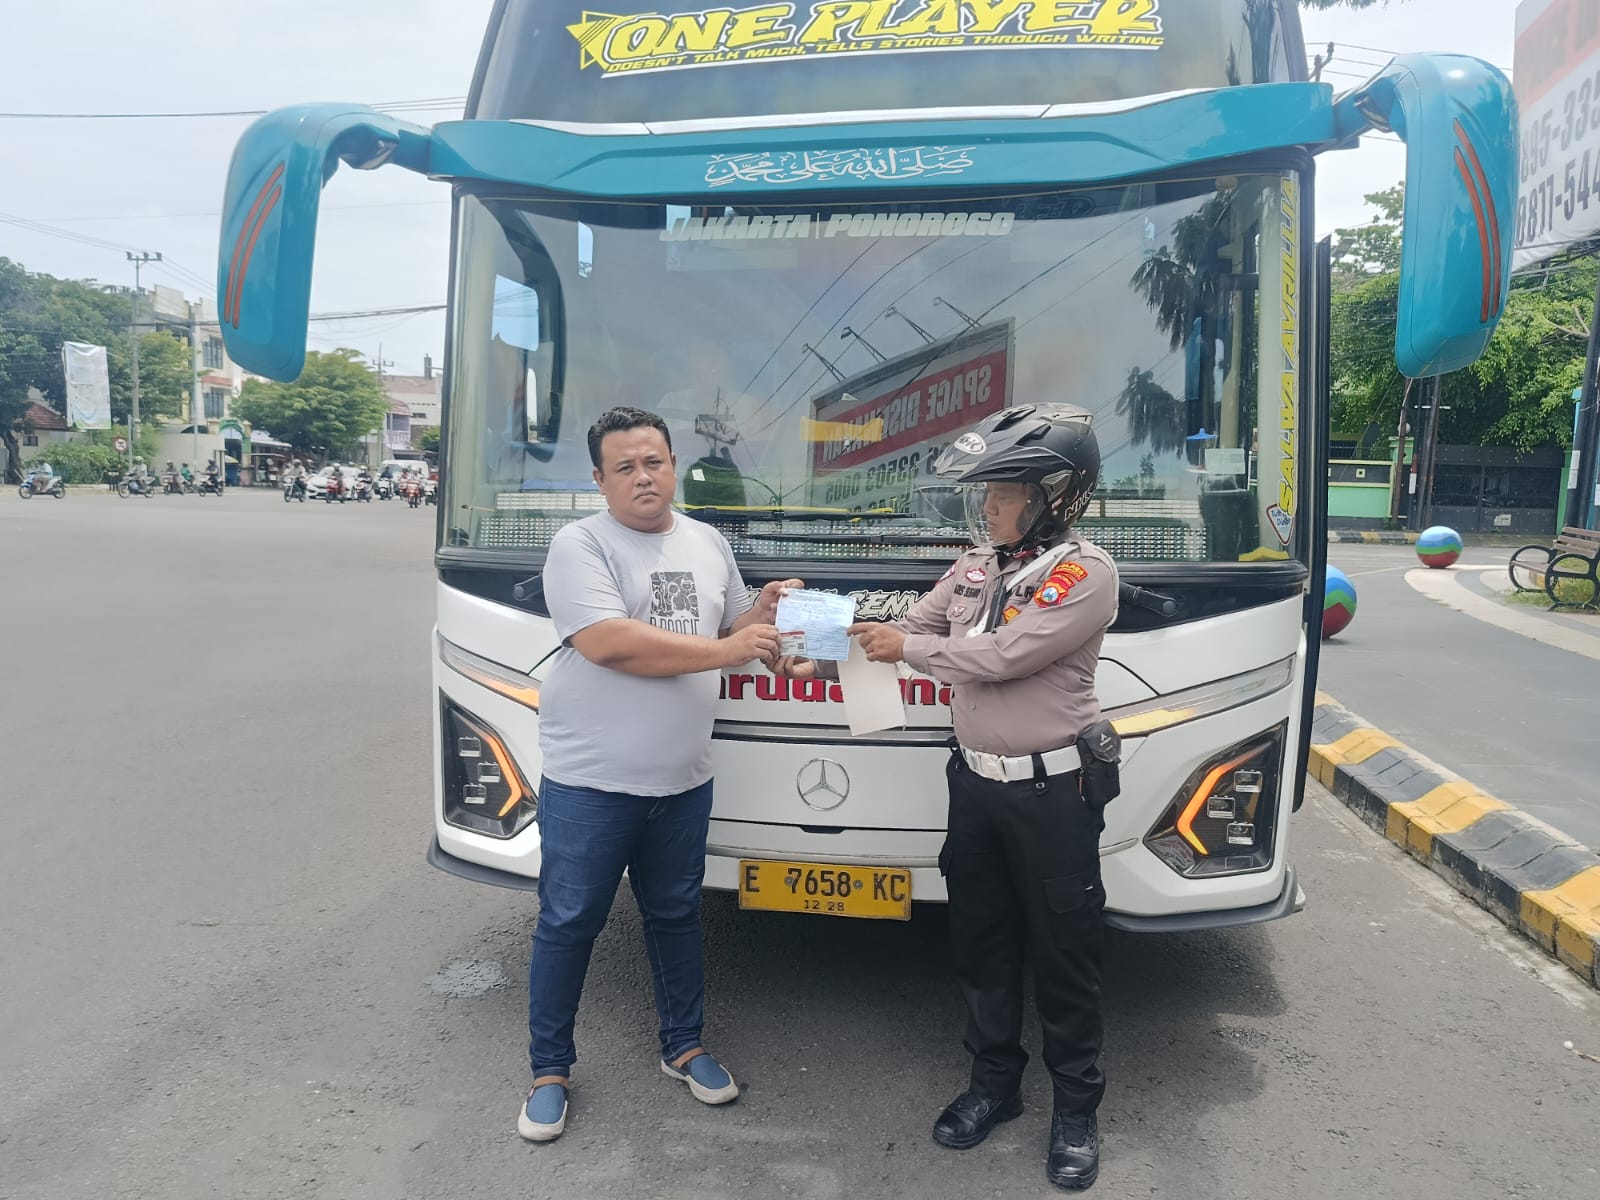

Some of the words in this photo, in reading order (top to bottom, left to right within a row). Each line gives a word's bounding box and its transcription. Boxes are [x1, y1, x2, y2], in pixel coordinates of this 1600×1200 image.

[606, 4, 793, 61] ONE
[798, 0, 1158, 45] PLAYER
[607, 55, 686, 72] DOESN'T
[693, 52, 745, 63] TALK
[745, 45, 807, 58] MUCH,
[816, 41, 872, 52] TELLS
[879, 36, 965, 49] STORIES
[974, 34, 1068, 44] THROUGH
[1075, 34, 1165, 46] WRITING
[659, 214, 811, 241] JAKARTA
[824, 211, 1015, 238] PONOROGO
[1279, 371, 1296, 516] SALWA
[745, 865, 760, 893] E
[787, 868, 852, 898] 7658
[873, 873, 906, 902] KC
[804, 900, 820, 910] 12
[828, 902, 845, 912] 28
